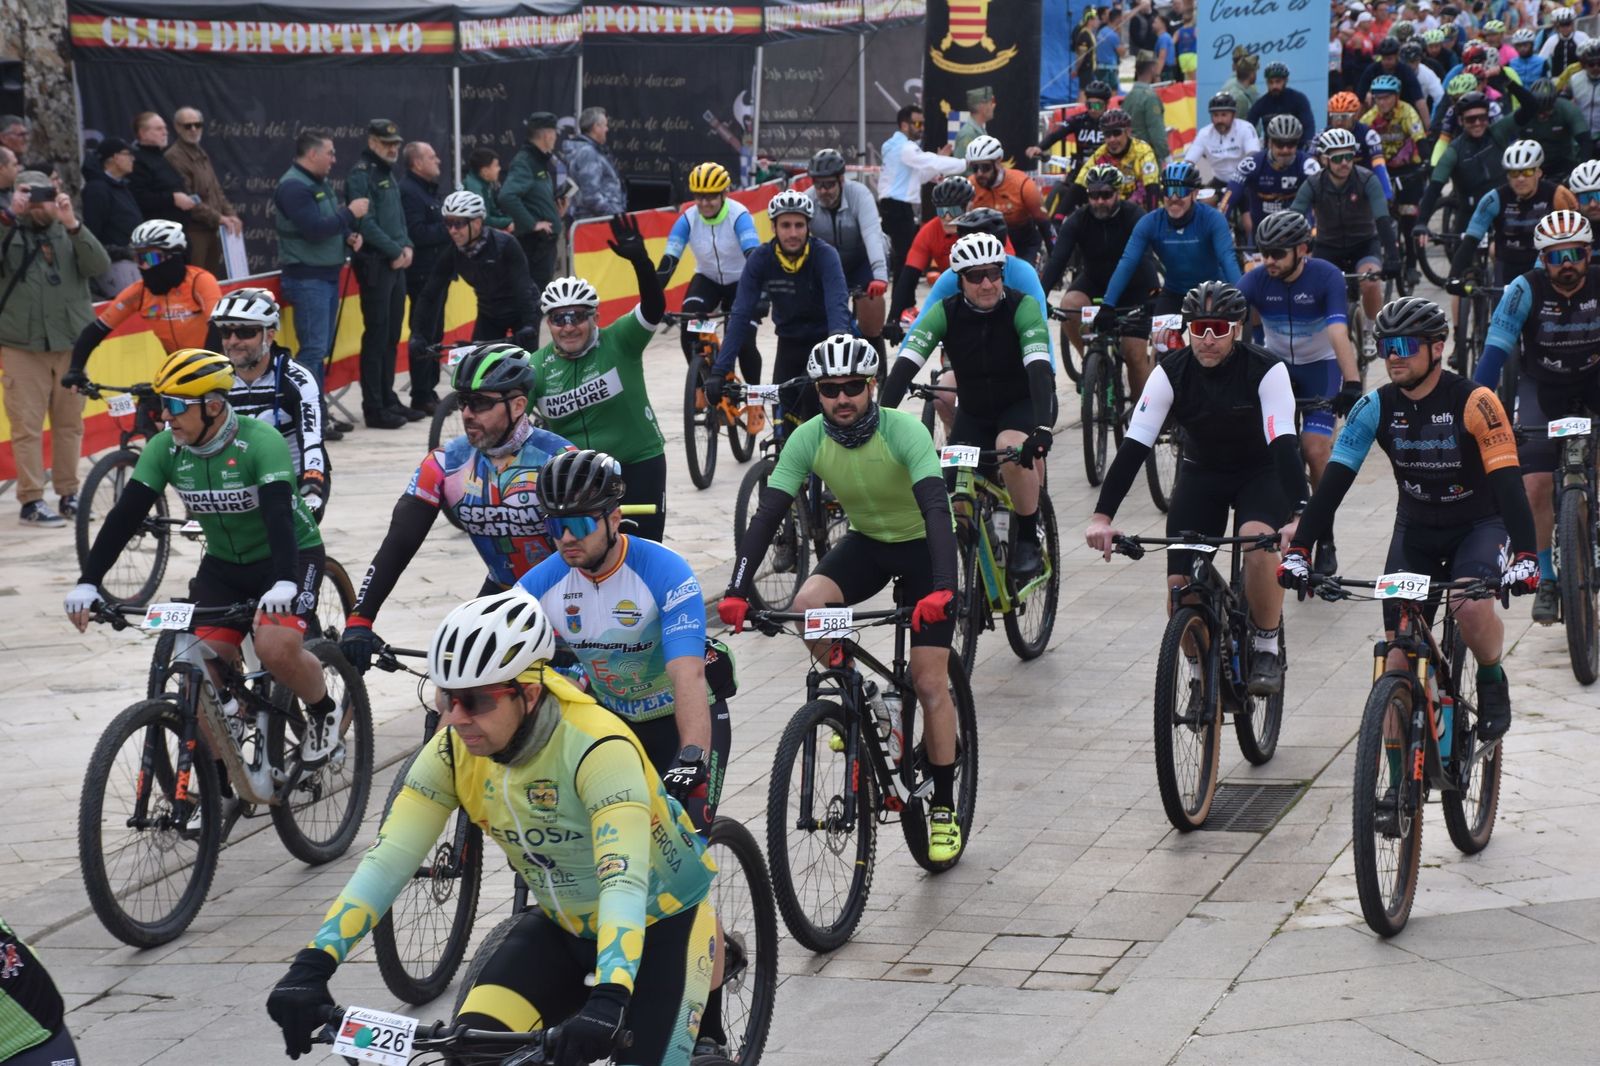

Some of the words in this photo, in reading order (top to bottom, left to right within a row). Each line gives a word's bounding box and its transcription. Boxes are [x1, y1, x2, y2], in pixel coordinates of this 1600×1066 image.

[102, 16, 198, 50] CLUB
[210, 22, 423, 54] DEPORTIVO
[1212, 28, 1311, 59] Dporte
[546, 378, 607, 407] ANDALUCIA
[548, 387, 611, 417] NATURE
[113, 400, 131, 412] 289
[302, 402, 316, 433] KTM
[1431, 412, 1454, 425] telfy
[458, 505, 540, 524] SEPTEM
[1396, 580, 1425, 592] 497
[162, 610, 188, 623] 363
[823, 617, 848, 630] 588
[175, 770, 190, 800] FOX
[370, 1026, 405, 1052] 226
